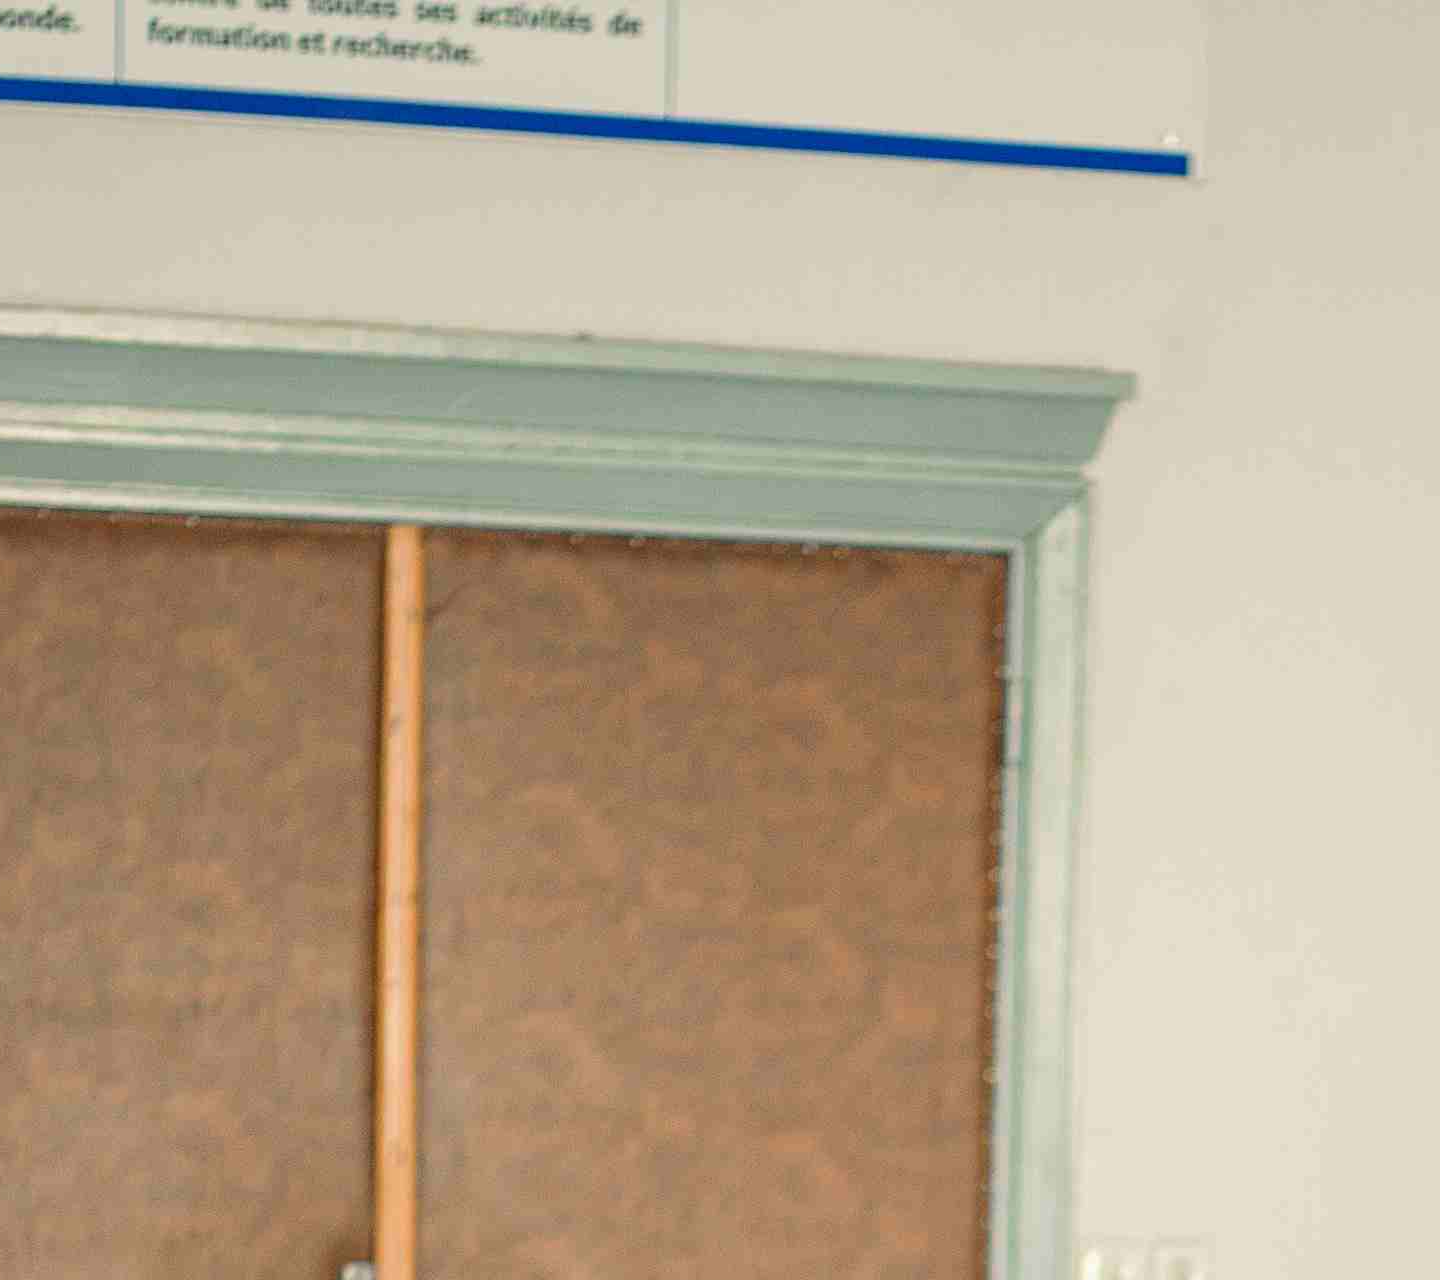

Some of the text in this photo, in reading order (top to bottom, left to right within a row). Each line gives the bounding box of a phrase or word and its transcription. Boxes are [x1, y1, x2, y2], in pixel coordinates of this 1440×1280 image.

[147, 15, 292, 48] formation
[297, 31, 326, 54] et
[415, 2, 458, 23] ses
[608, 12, 643, 36] de
